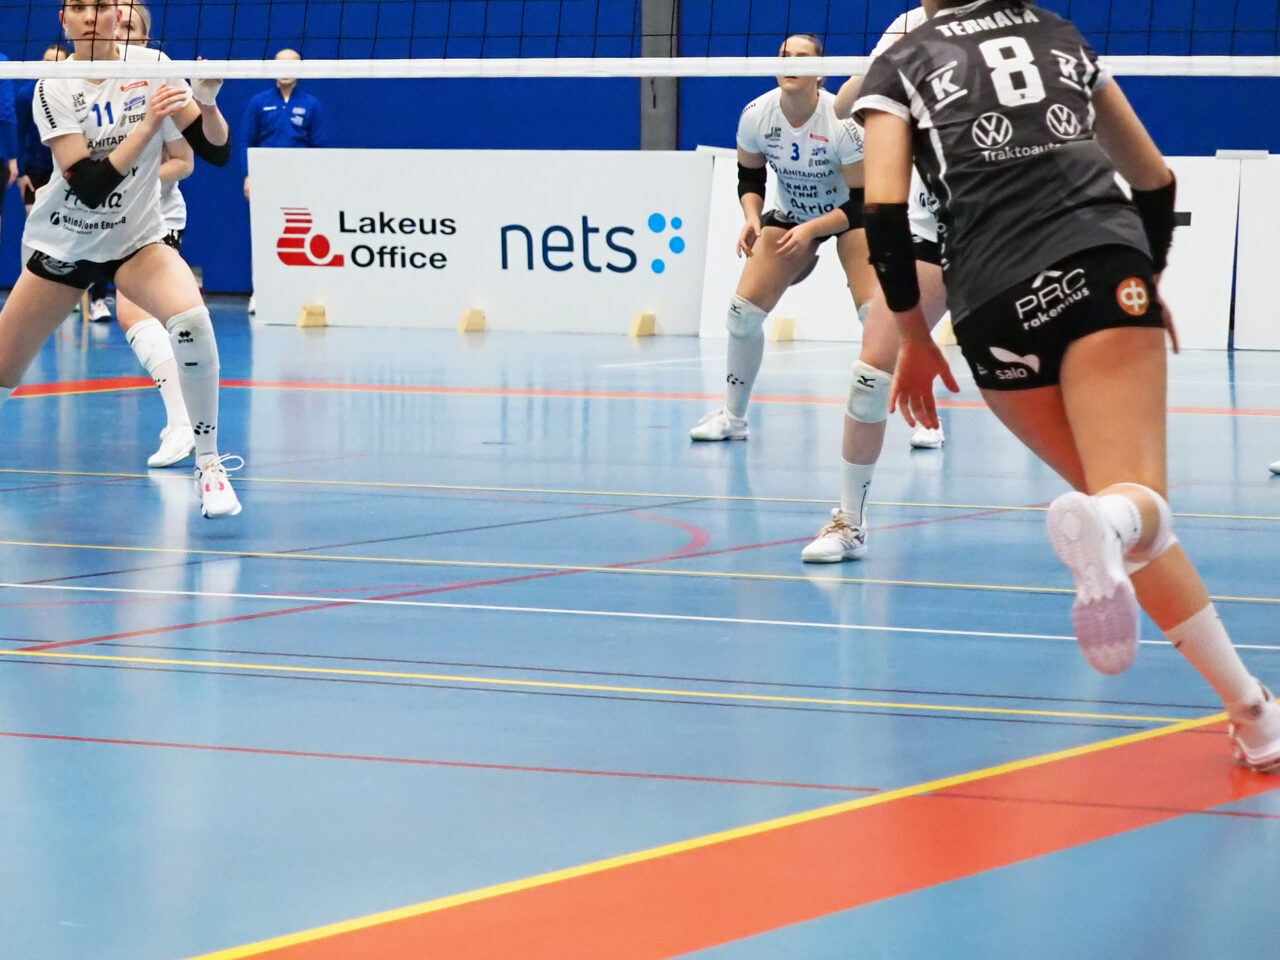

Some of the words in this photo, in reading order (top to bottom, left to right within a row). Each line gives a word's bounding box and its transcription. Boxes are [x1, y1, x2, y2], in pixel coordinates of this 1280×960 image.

[978, 36, 1047, 107] 8
[92, 101, 114, 127] 11
[790, 142, 800, 161] 3
[338, 210, 456, 236] Lakeus
[351, 243, 448, 270] Office
[501, 215, 638, 274] nets
[995, 366, 1028, 381] salo
